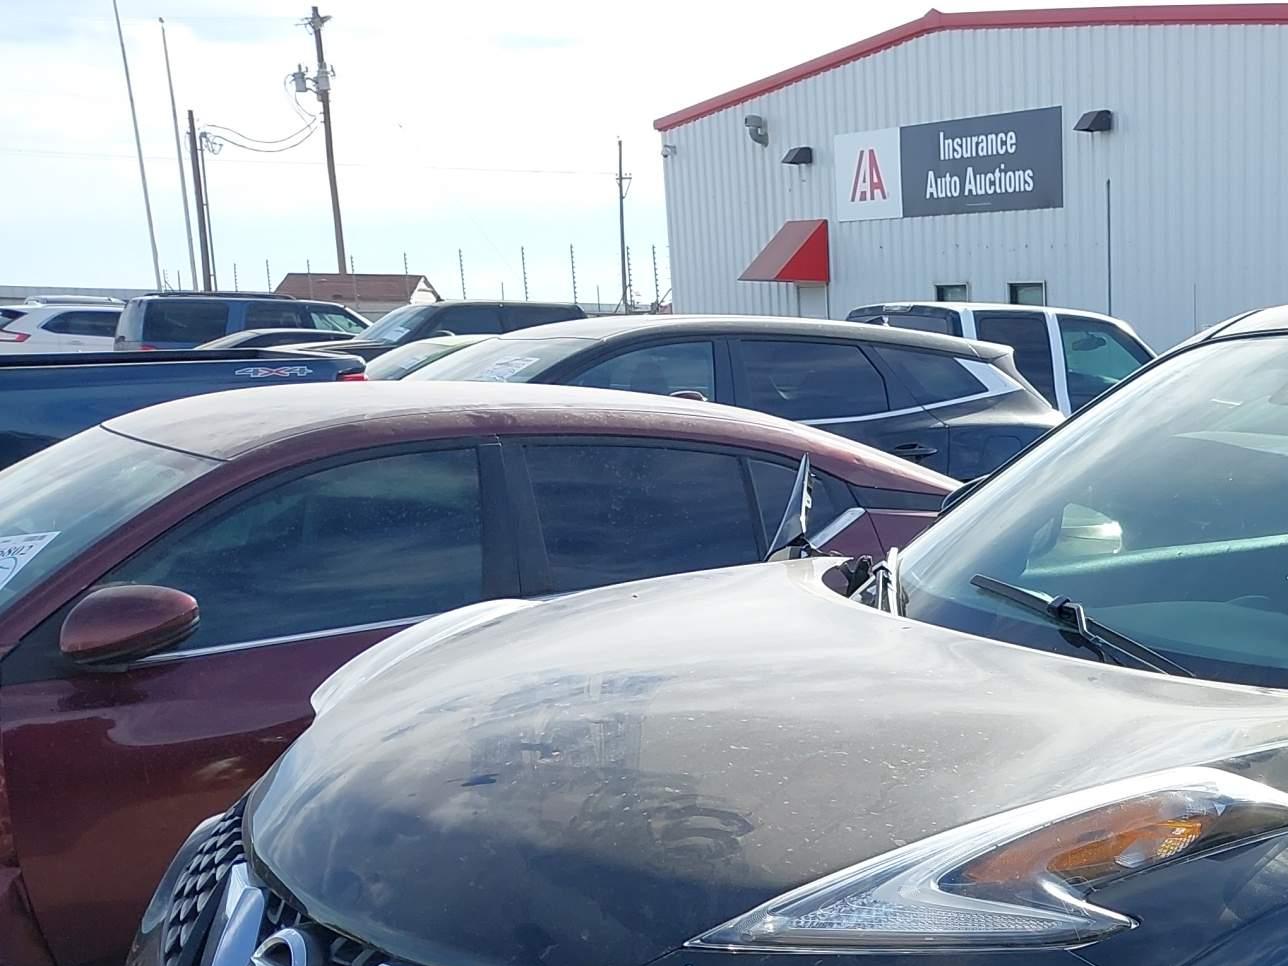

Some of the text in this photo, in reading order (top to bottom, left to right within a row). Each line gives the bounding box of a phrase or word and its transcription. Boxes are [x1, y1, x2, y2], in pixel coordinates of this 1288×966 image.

[939, 131, 1016, 161] Insurance
[926, 164, 1034, 199] Auto Auctions
